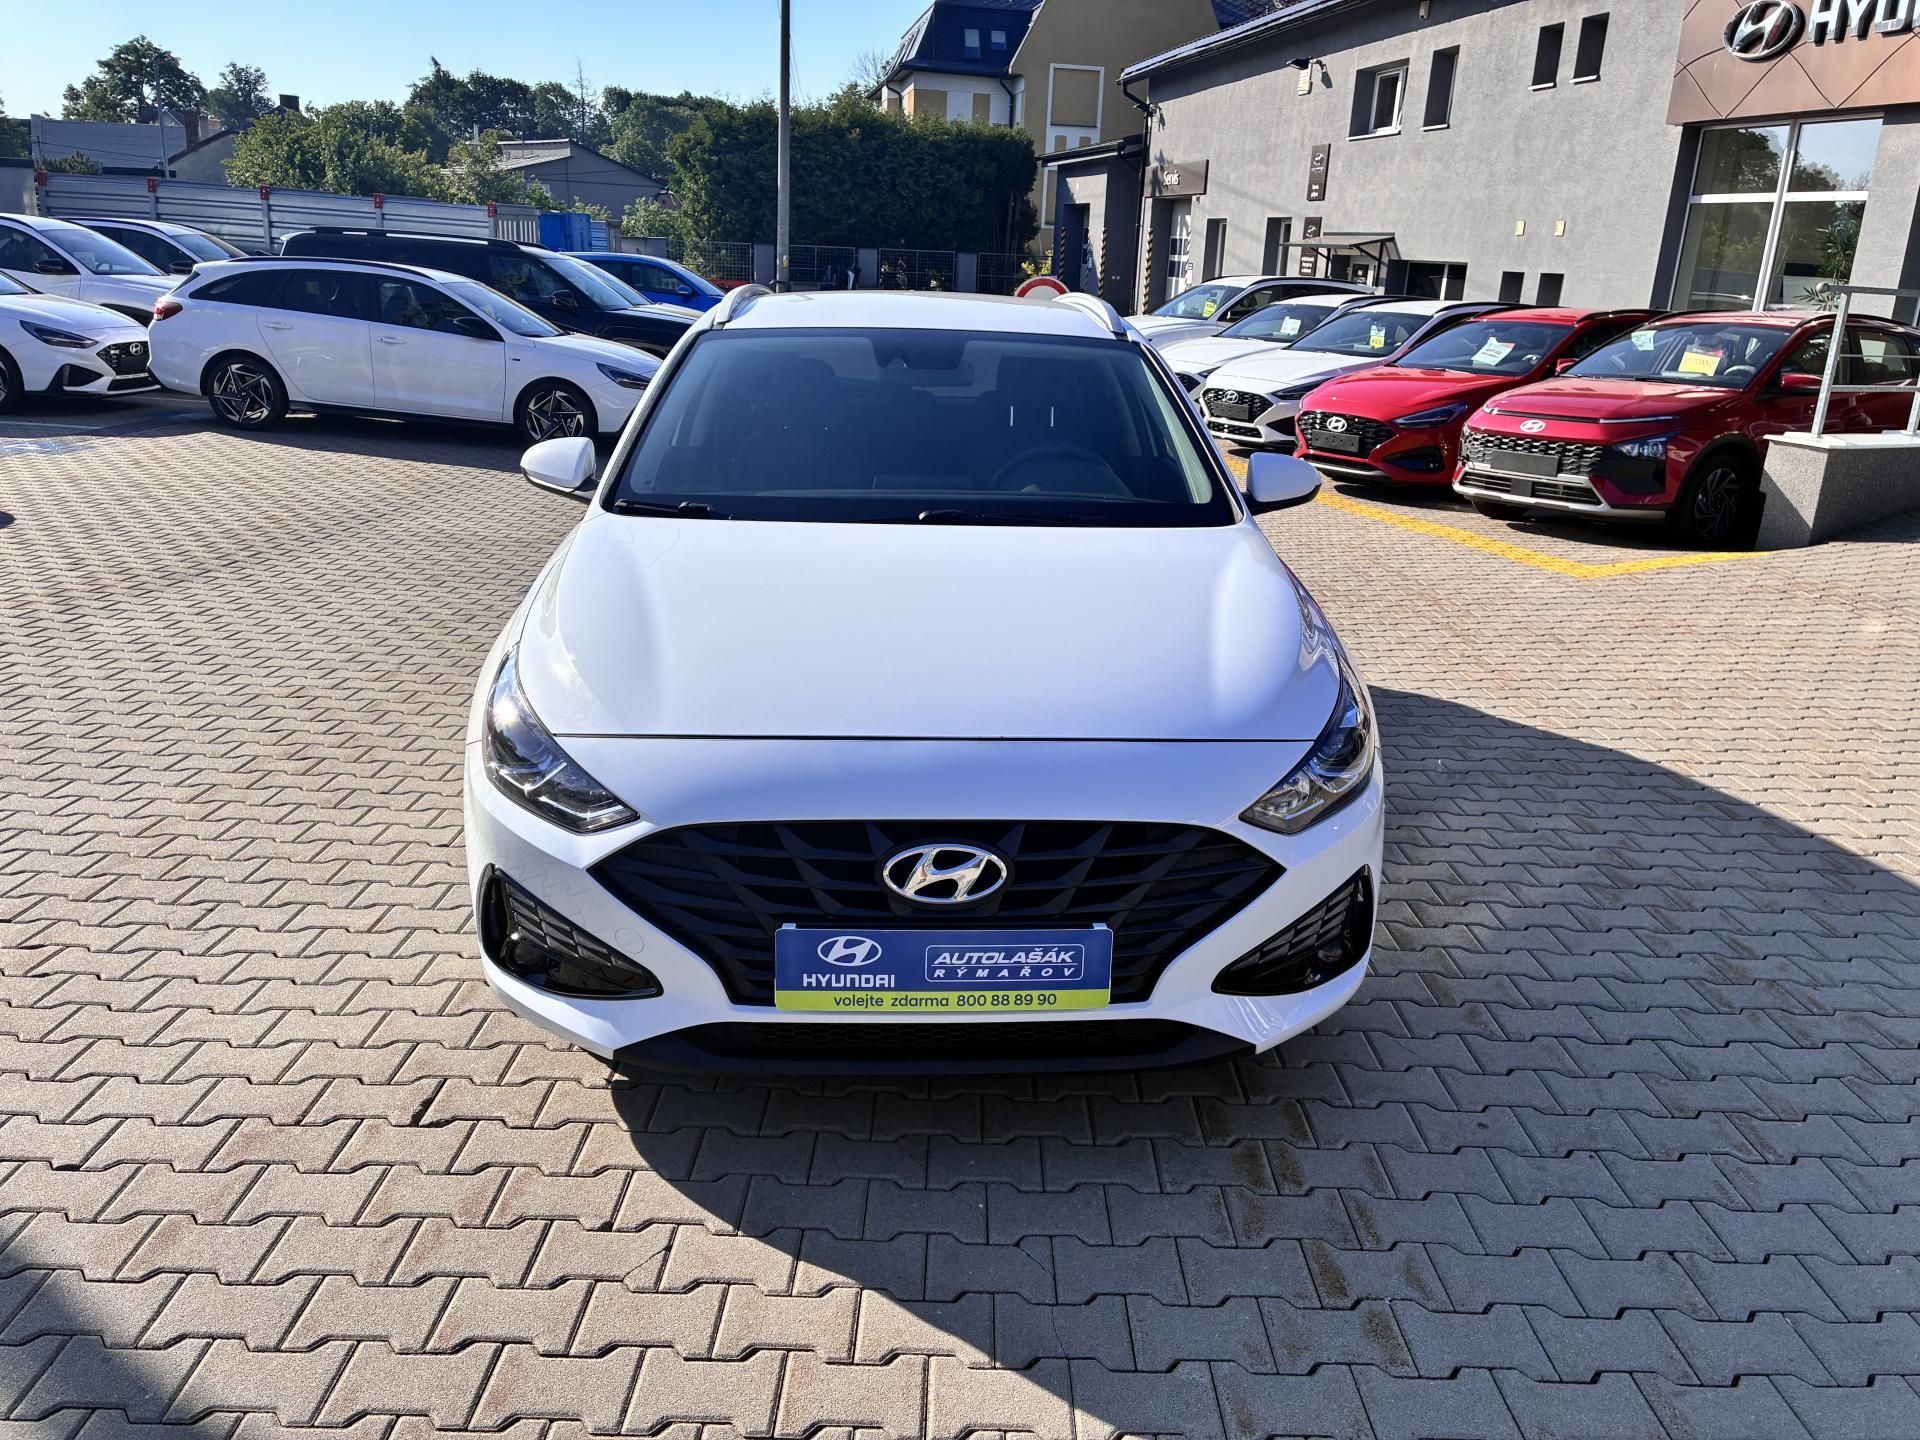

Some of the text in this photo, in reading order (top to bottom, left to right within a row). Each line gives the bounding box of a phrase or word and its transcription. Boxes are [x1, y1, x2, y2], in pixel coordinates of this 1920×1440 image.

[1807, 0, 1920, 43] HYU
[933, 947, 1076, 965] AUTOLAŠÁK
[933, 966, 1075, 978] RÝMAŘOV
[802, 973, 895, 988] HYUNDAI
[833, 993, 1057, 1008] volejte zdarma 800 88 89 90
